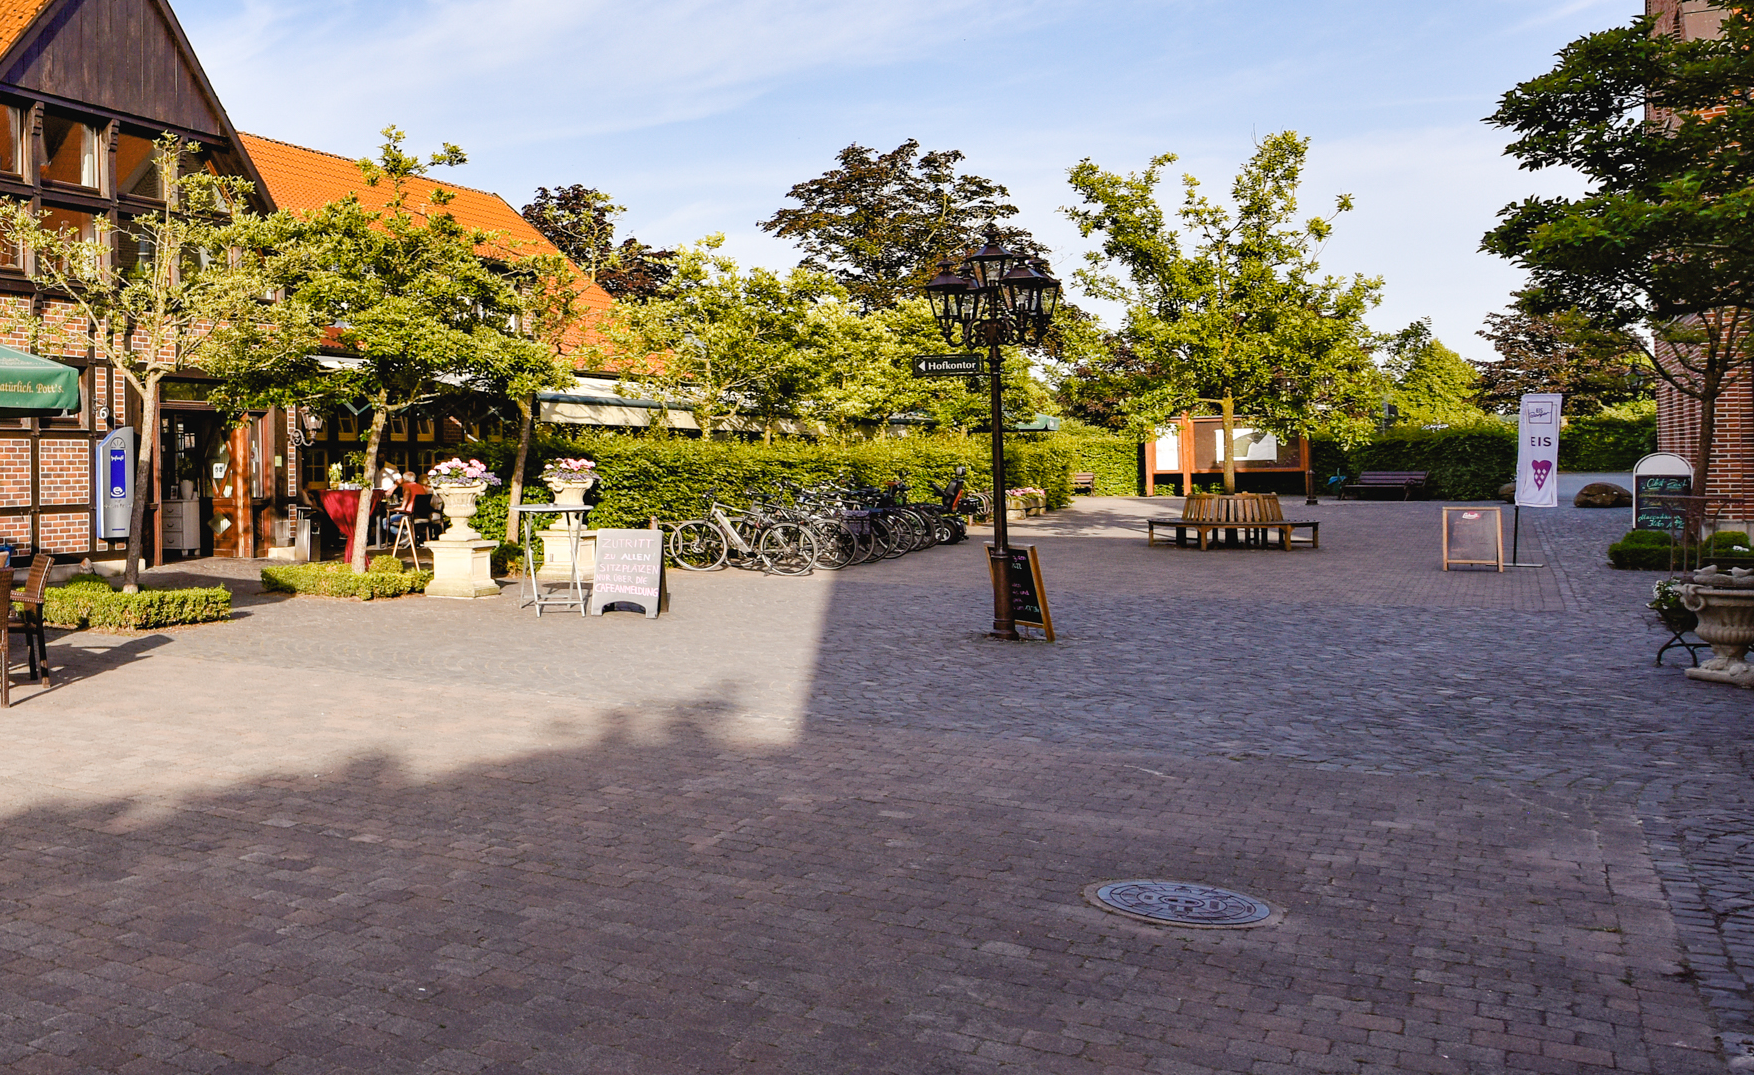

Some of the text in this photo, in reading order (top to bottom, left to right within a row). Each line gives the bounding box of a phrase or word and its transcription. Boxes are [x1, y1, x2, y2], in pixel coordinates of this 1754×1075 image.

[928, 360, 976, 371] Hofkontor
[36, 382, 64, 394] Pott's.
[99, 406, 108, 419] 6
[1530, 436, 1552, 447] EIS
[602, 538, 655, 548] ZUTRITT
[596, 573, 611, 581] NUR
[635, 576, 648, 585] DIE
